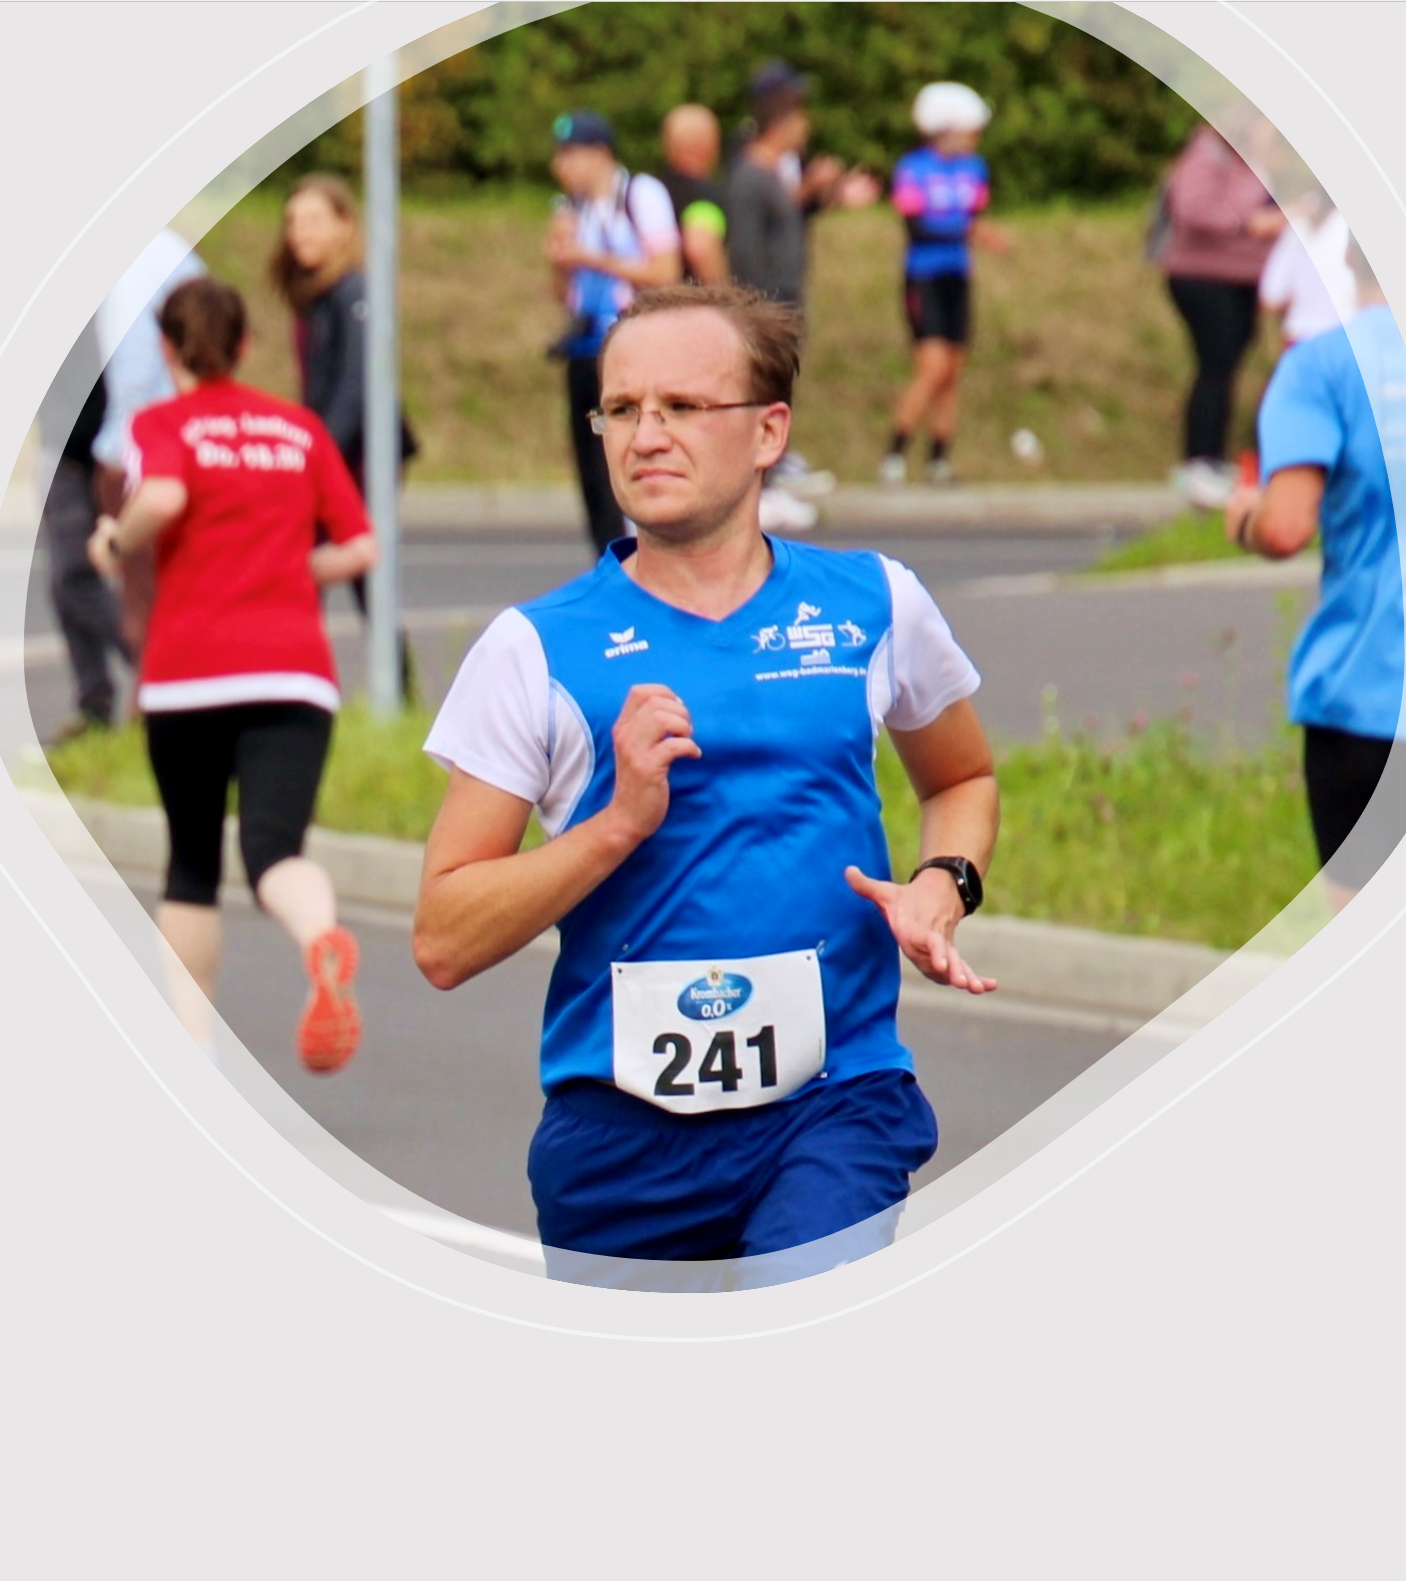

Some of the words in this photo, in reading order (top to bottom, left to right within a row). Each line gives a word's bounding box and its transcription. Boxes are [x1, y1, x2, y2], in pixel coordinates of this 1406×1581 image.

[786, 623, 836, 649] WSG
[604, 639, 650, 659] erima
[690, 986, 742, 1000] Krombacher
[652, 1025, 777, 1096] 241
